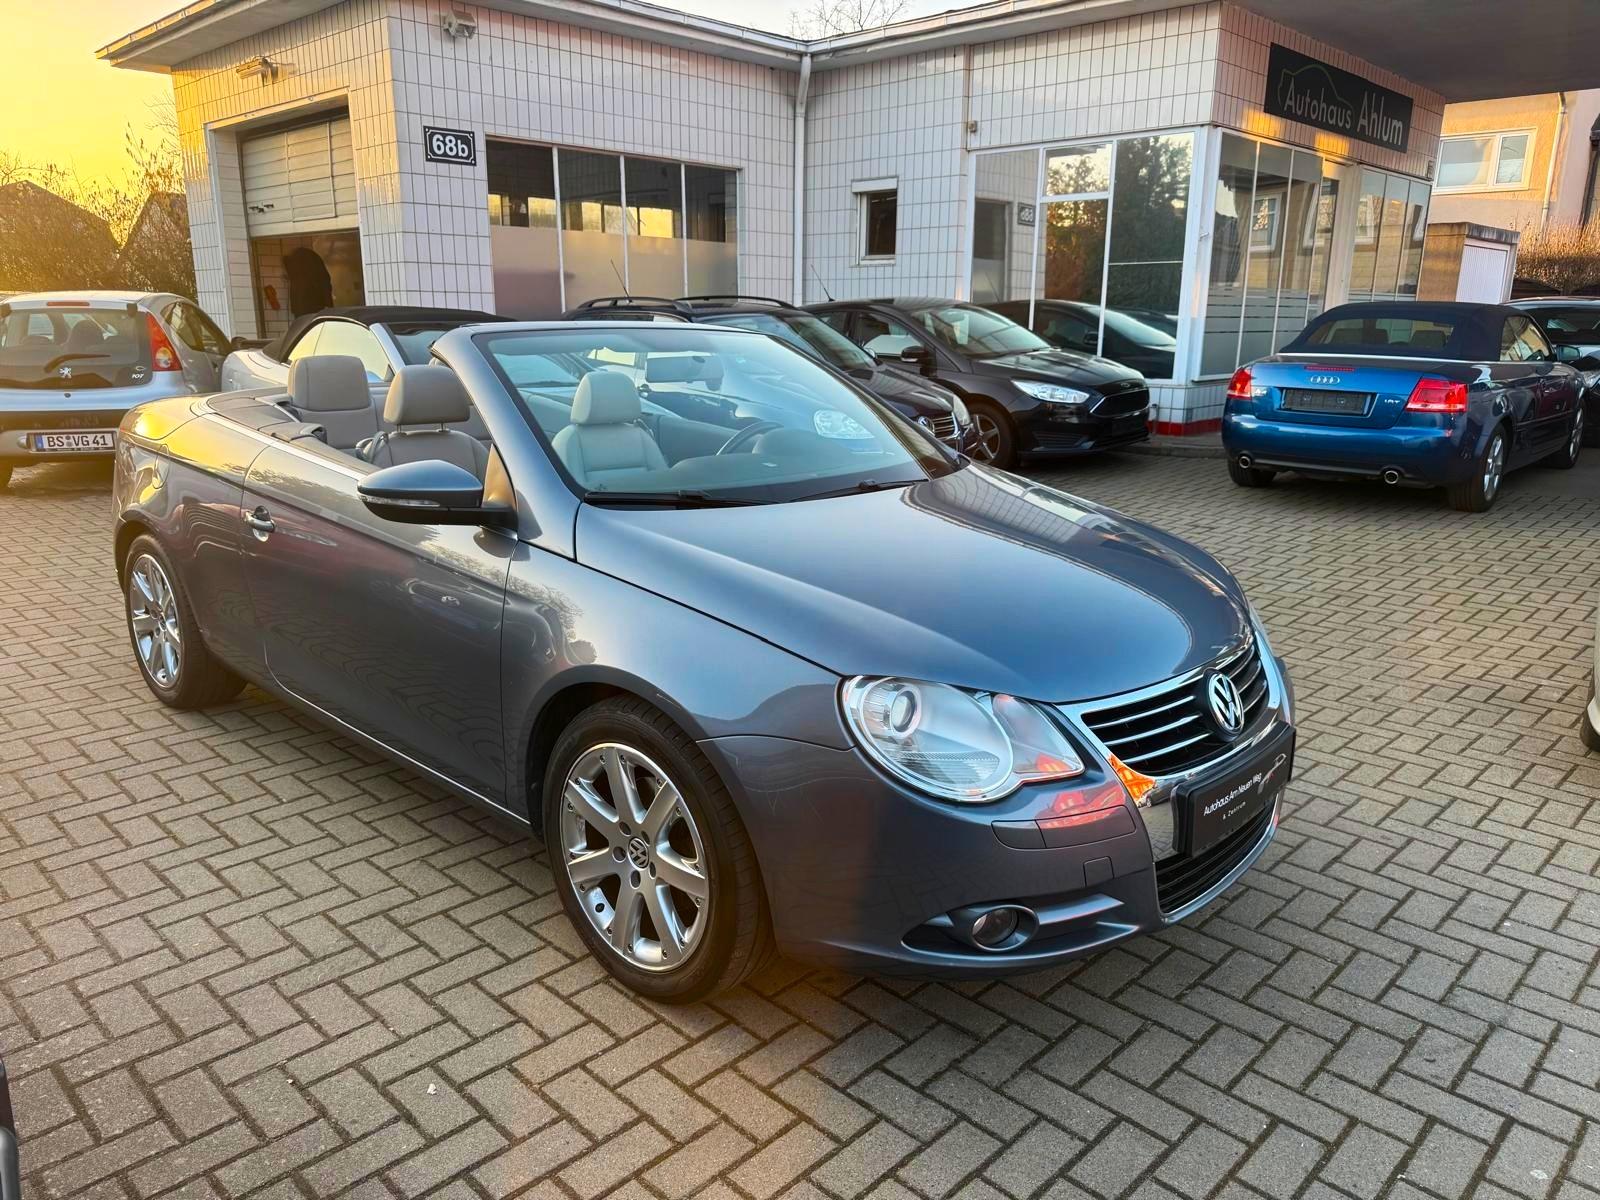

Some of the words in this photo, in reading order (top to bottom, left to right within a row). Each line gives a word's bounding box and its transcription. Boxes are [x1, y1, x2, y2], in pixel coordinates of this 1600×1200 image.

[1284, 77, 1351, 129] Autohaus
[1356, 91, 1403, 145] Ahlum
[432, 133, 469, 158] 68b
[46, 435, 65, 448] BS
[72, 435, 90, 447] VG
[92, 434, 109, 446] 41
[1204, 795, 1230, 816] Autohaus
[1230, 790, 1240, 799] Am
